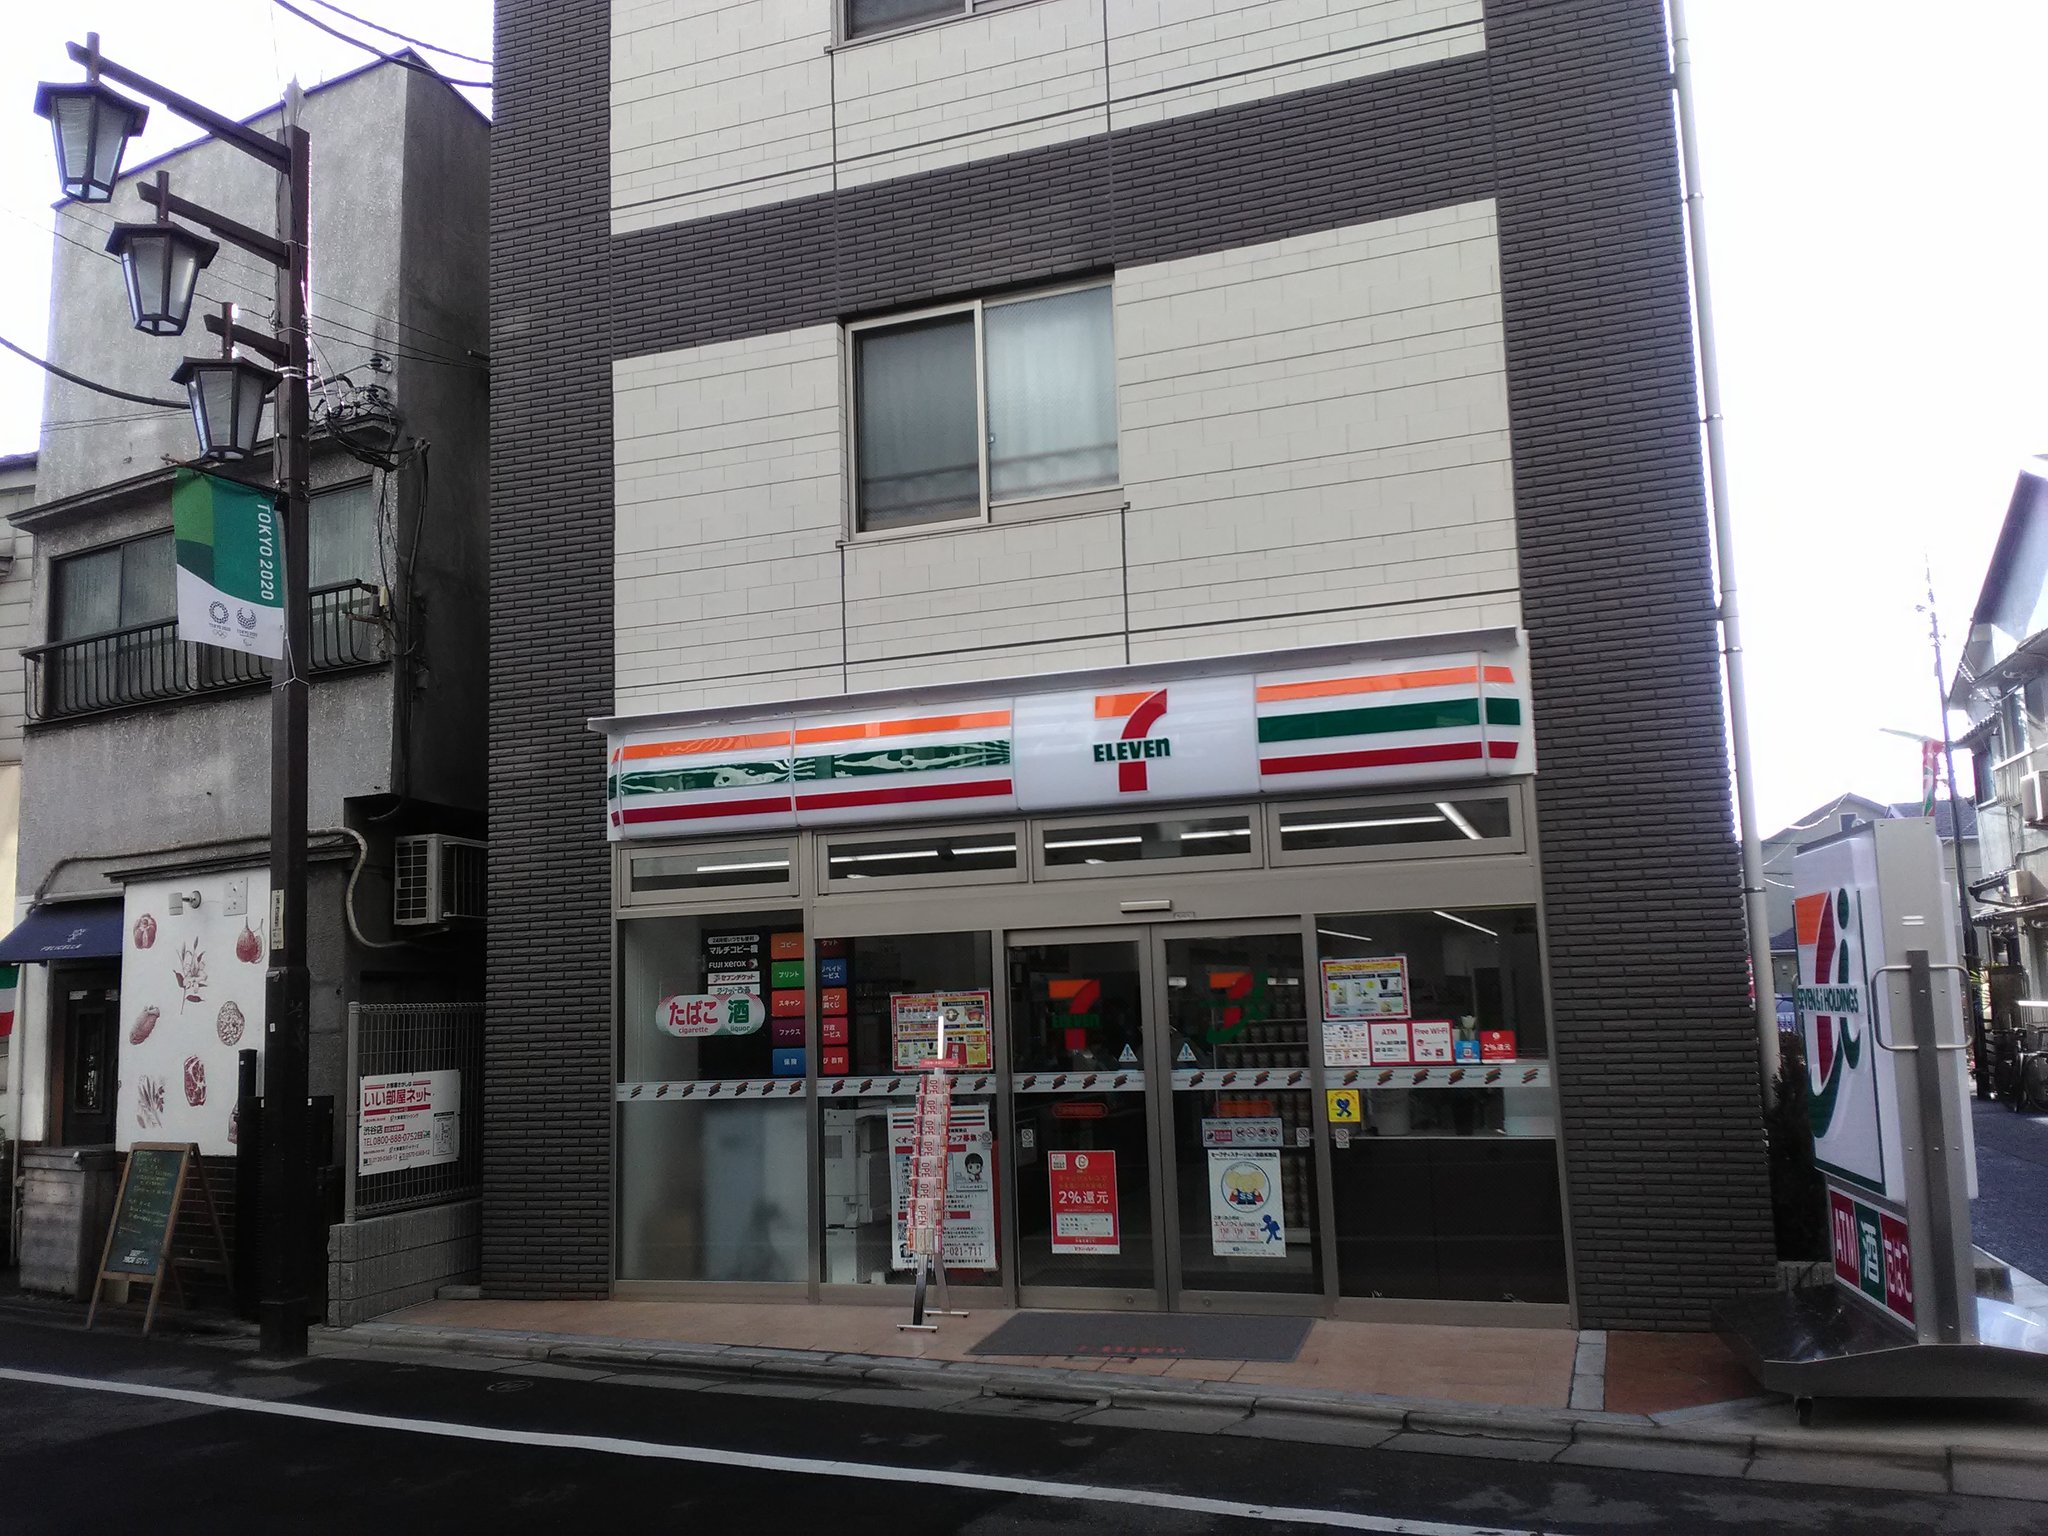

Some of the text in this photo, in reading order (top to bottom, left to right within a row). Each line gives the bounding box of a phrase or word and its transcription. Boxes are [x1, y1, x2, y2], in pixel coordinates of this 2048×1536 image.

[257, 504, 275, 601] TOKYO 2020
[708, 944, 759, 955] マルチコピー機
[708, 960, 747, 969] FUJI xerox
[721, 973, 756, 981] セブンチケット
[1823, 987, 1859, 1014] HOLDINGS
[669, 1001, 719, 1026] たばこ
[727, 999, 750, 1024] 酒
[678, 1026, 709, 1035] cigarette
[730, 1025, 751, 1034] liquor
[364, 1087, 431, 1107] いい部屋ネット
[363, 1125, 383, 1135] 渋谷店
[363, 1138, 373, 1146] TEL
[1058, 1190, 1109, 1205] 2%還元
[918, 1204, 927, 1226] OPEN
[1835, 1207, 1858, 1271] ATM
[1860, 1220, 1880, 1284] 酒
[1884, 1232, 1913, 1303] たばこ
